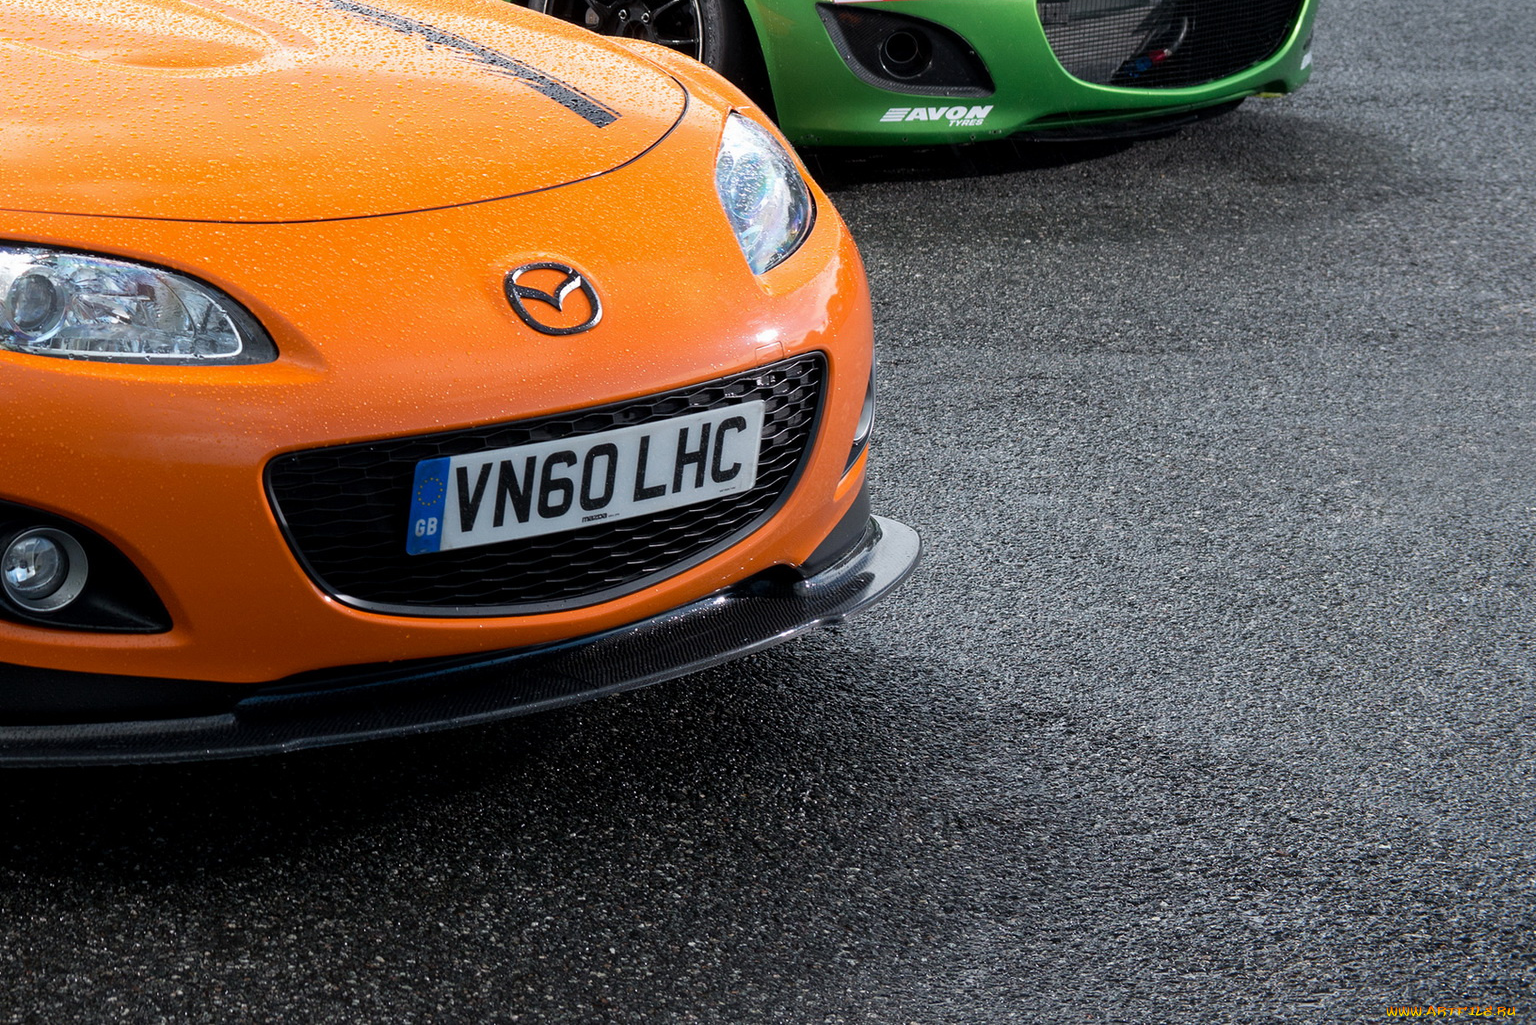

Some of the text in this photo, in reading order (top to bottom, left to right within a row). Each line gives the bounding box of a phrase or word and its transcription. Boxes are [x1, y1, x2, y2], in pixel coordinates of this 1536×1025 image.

[905, 105, 994, 121] AVON
[948, 119, 985, 127] TYRES
[456, 415, 747, 533] VN60 LHC
[581, 512, 608, 523] mazda
[415, 517, 438, 538] GB
